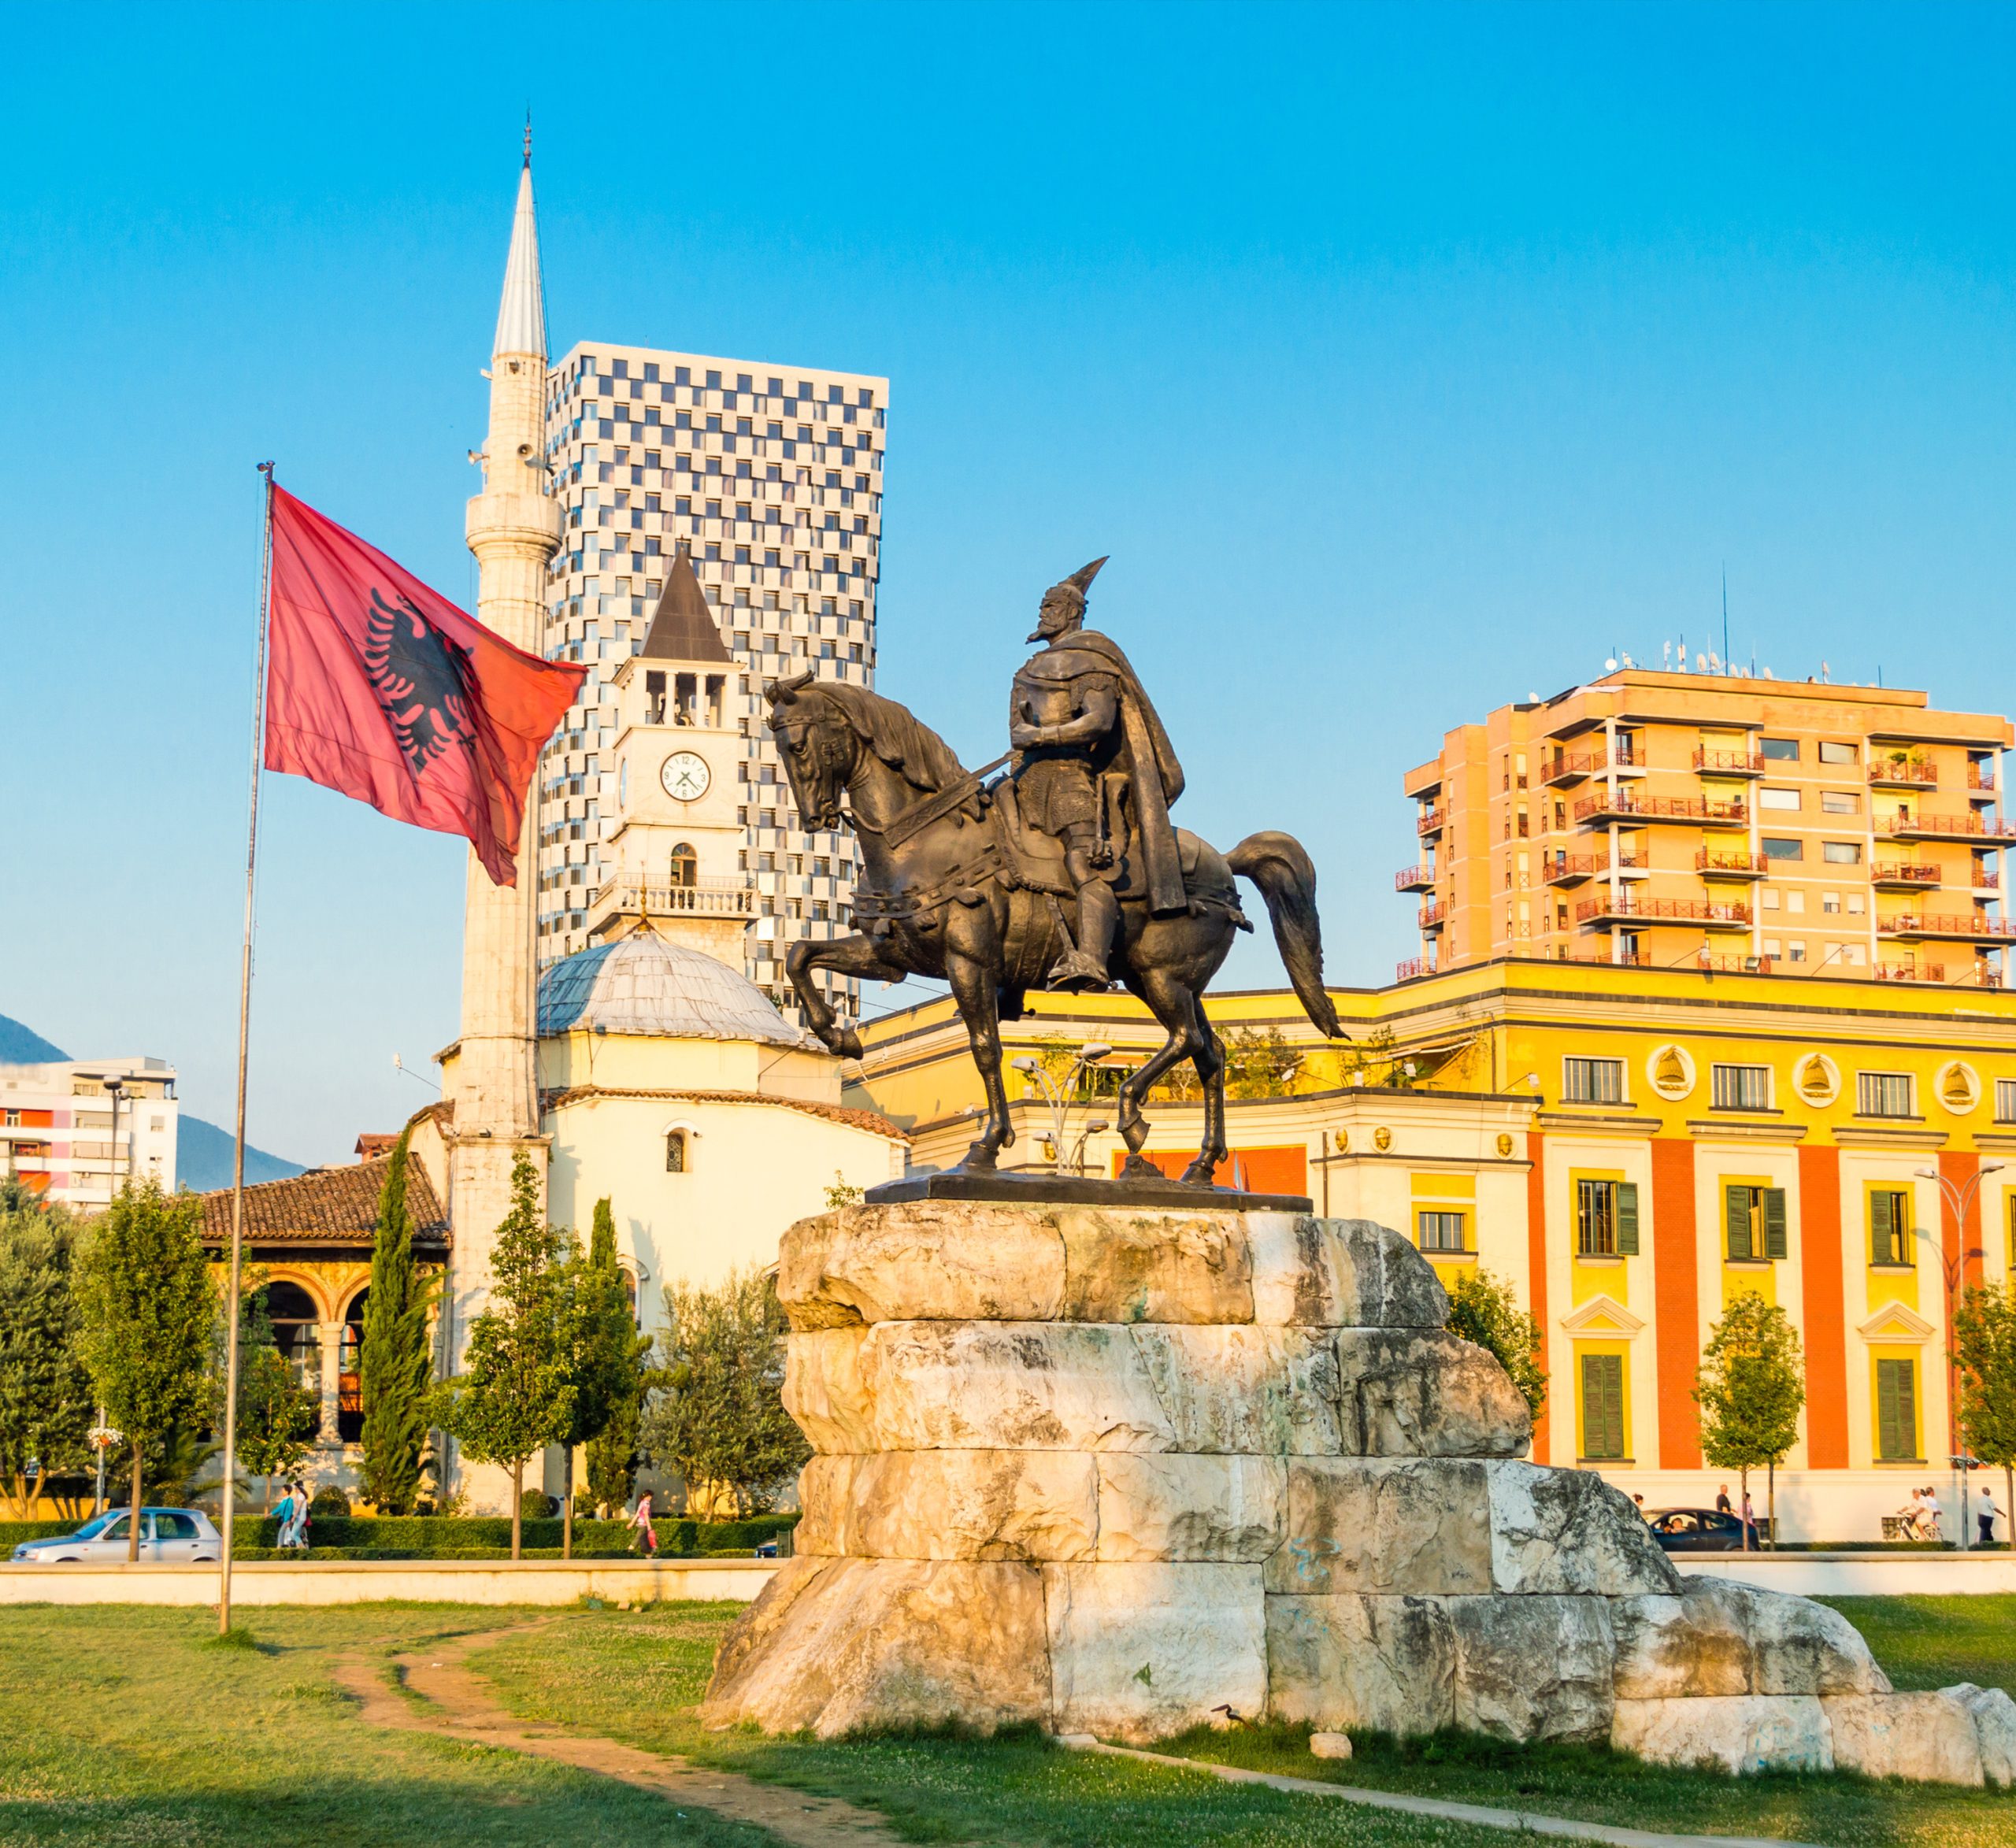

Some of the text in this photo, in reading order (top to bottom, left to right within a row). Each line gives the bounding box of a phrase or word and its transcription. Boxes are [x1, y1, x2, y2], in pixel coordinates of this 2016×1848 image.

[682, 756, 690, 765] 12
[664, 771, 669, 780] 9
[701, 774, 706, 783] 3
[682, 789, 687, 798] 6
